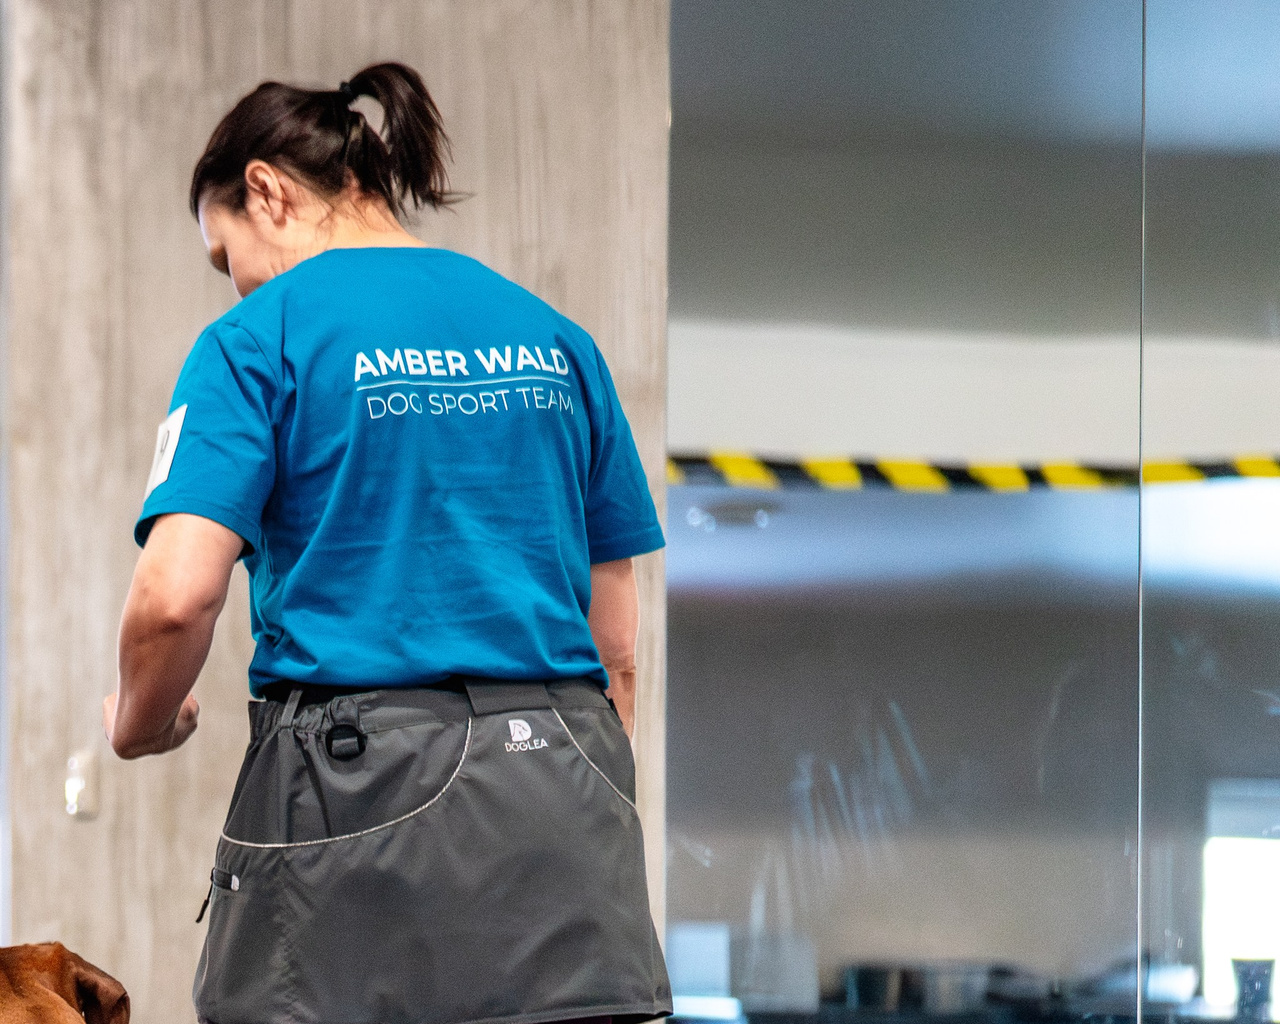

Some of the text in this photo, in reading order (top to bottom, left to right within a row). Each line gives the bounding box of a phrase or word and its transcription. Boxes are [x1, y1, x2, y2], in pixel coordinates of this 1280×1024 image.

[355, 345, 569, 382] AMBER WALD
[428, 389, 510, 415] SPORT
[516, 386, 574, 415] TEAM
[504, 738, 549, 752] DOGLEA
